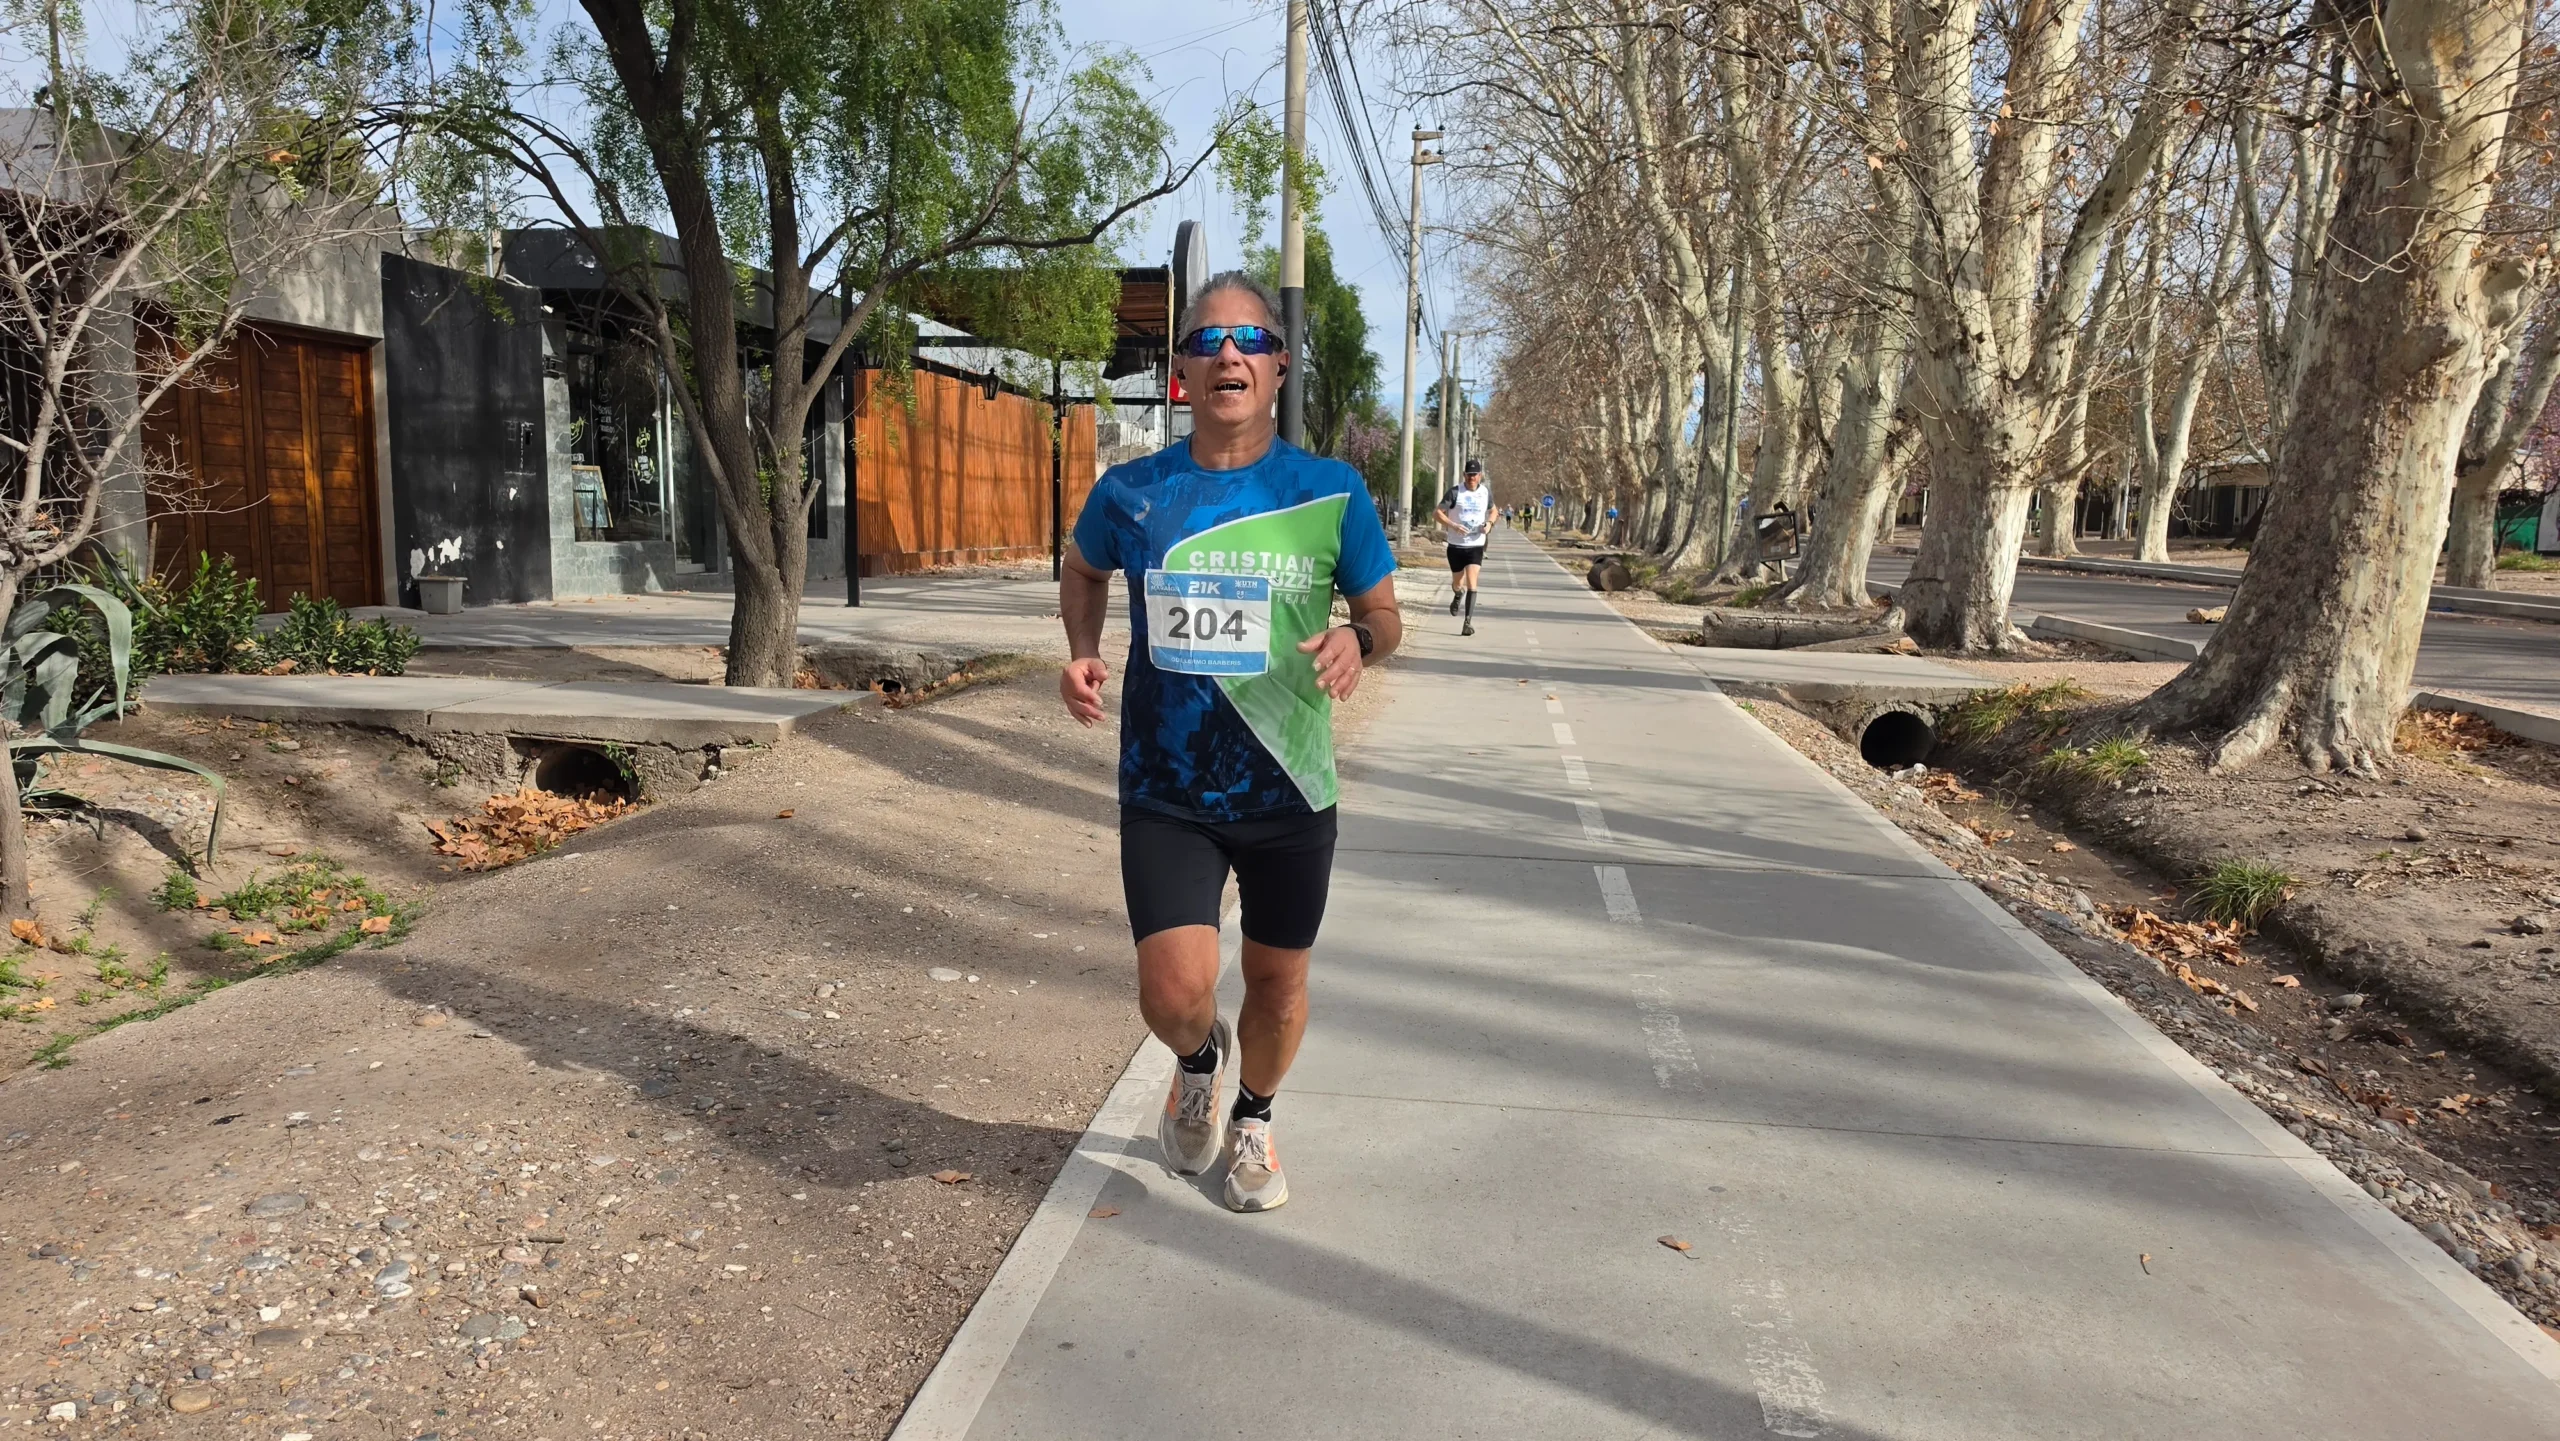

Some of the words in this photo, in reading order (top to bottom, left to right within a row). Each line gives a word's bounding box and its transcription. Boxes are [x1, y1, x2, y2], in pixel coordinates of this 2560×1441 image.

[1189, 551, 1315, 573] CRISTIAN
[1188, 581, 1221, 594] 21K
[1275, 592, 1310, 605] TEAM
[1168, 606, 1248, 642] 204
